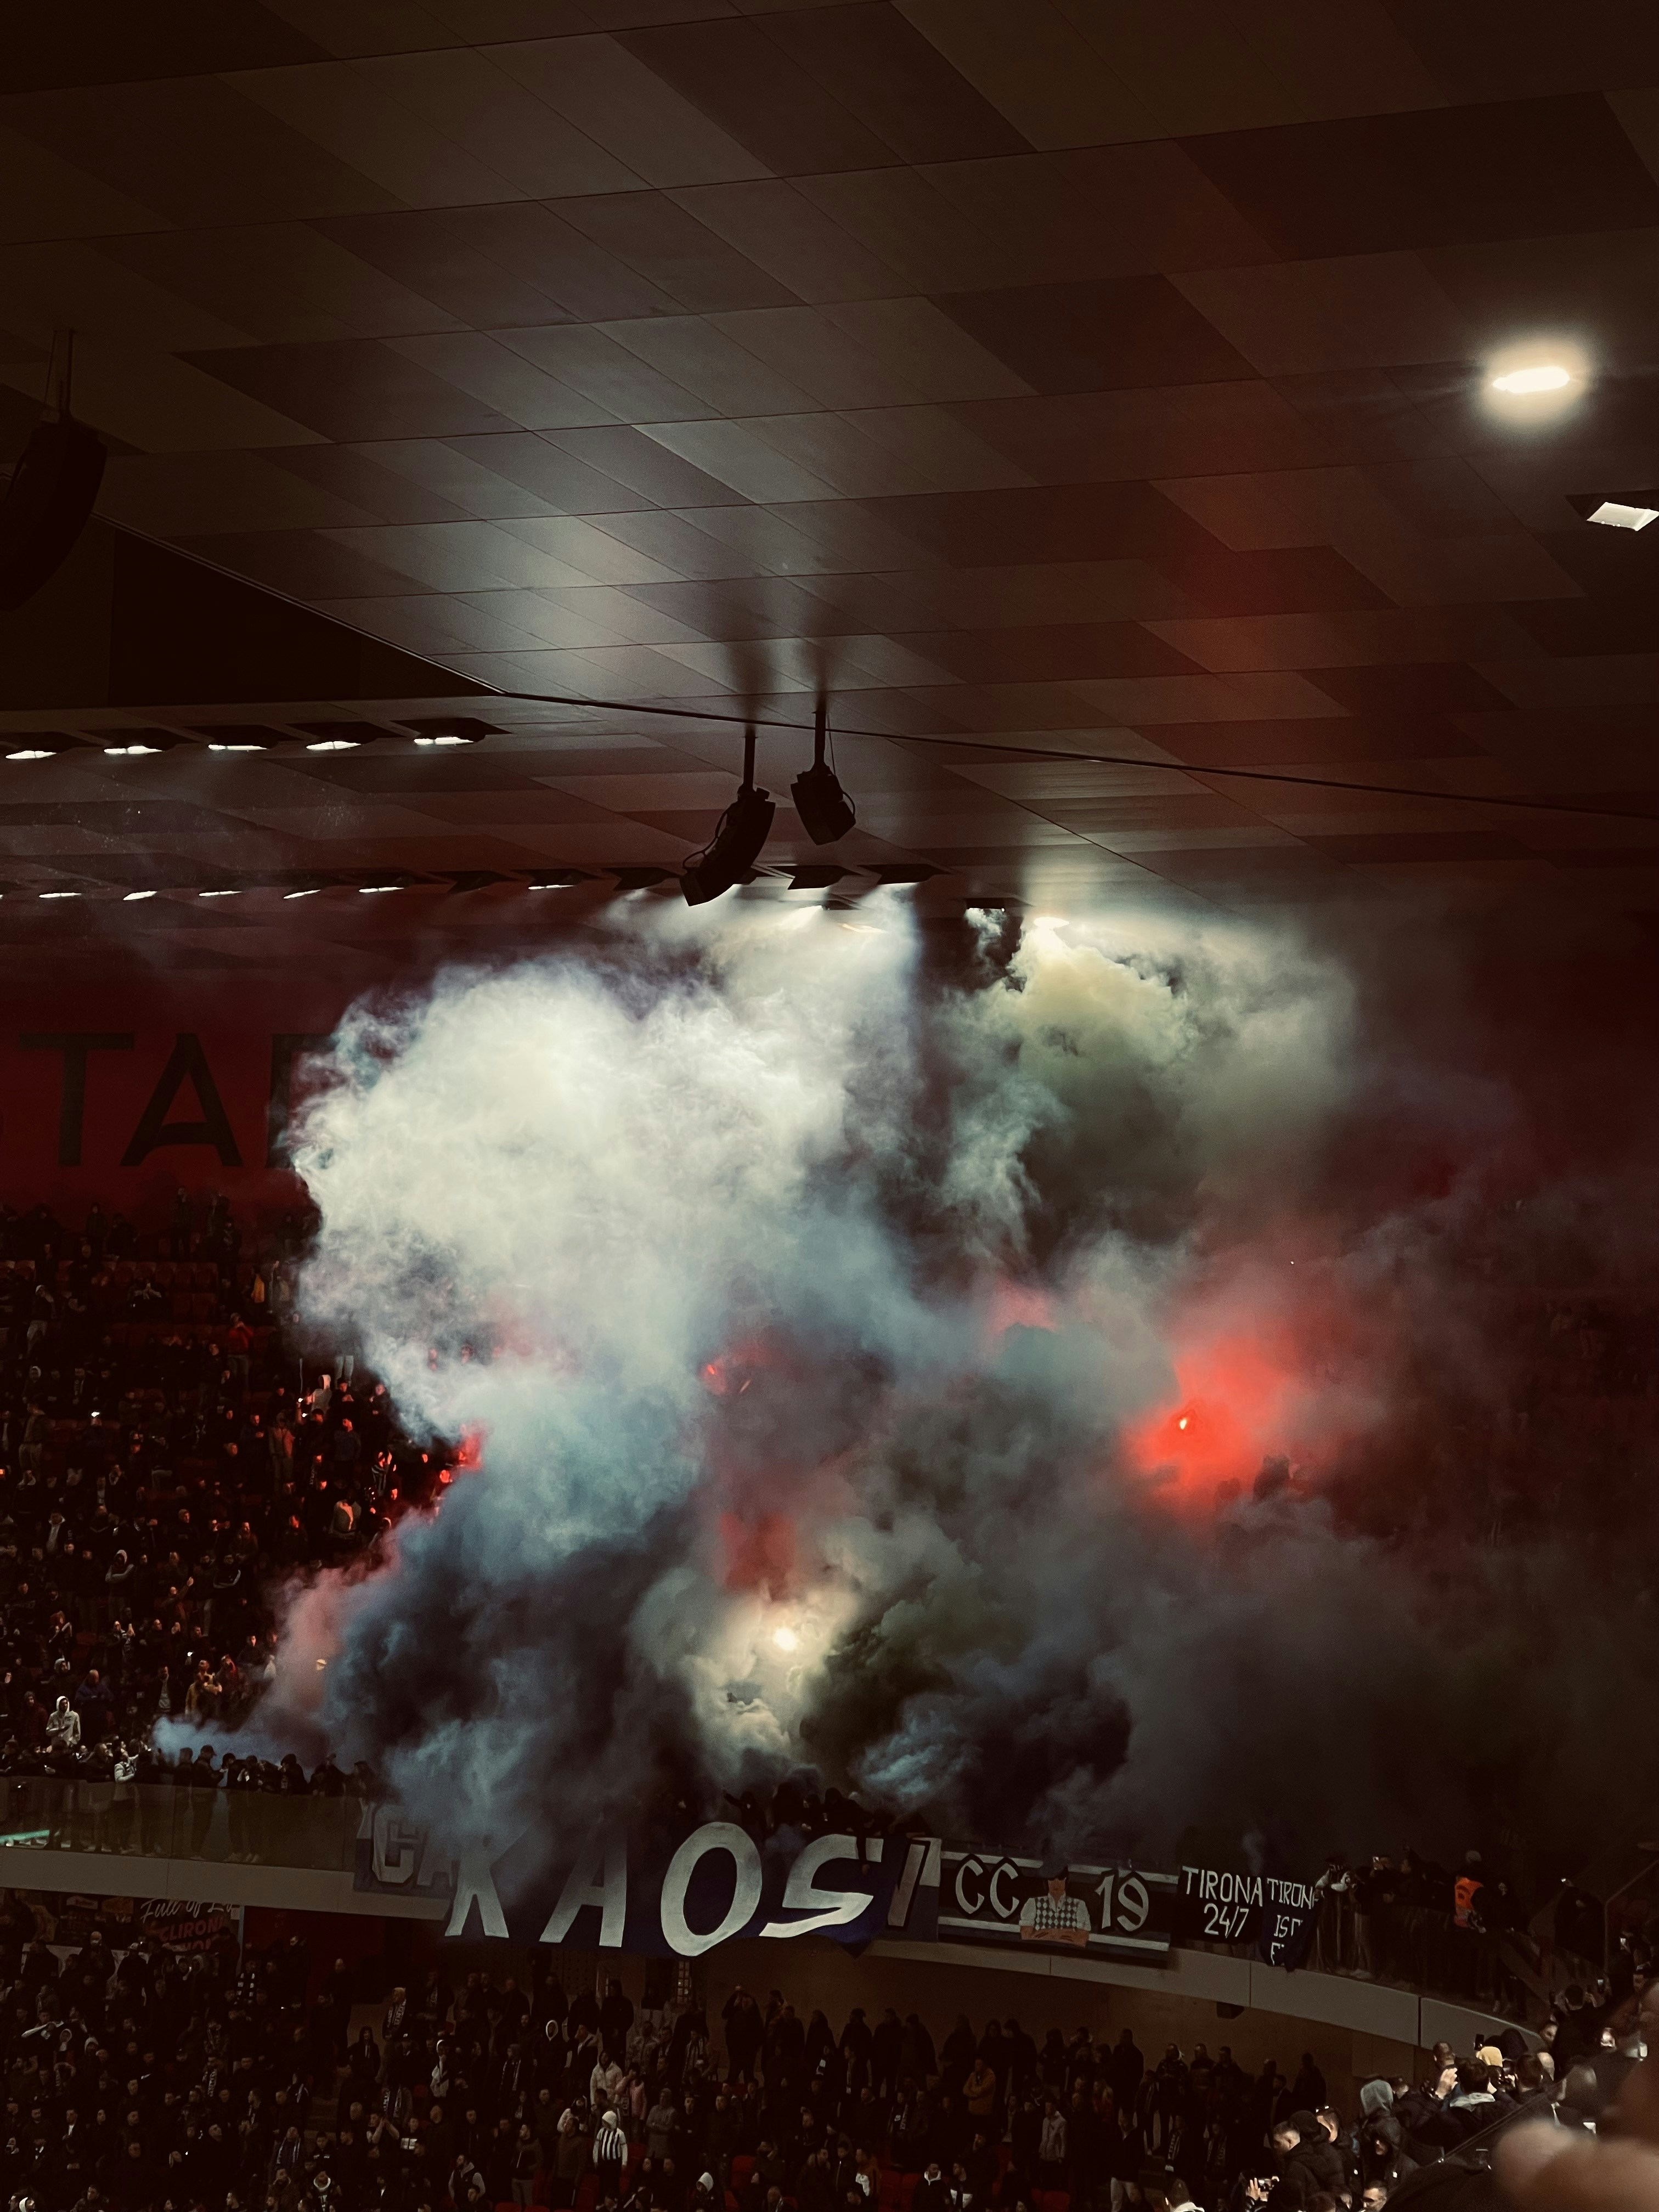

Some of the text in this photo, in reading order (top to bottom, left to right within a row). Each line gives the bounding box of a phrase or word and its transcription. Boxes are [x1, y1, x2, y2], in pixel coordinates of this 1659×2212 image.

[955, 1859, 1149, 1932] CC 19
[1182, 1865, 1263, 1908] TIRONA
[1203, 1902, 1250, 1939] 24/7
